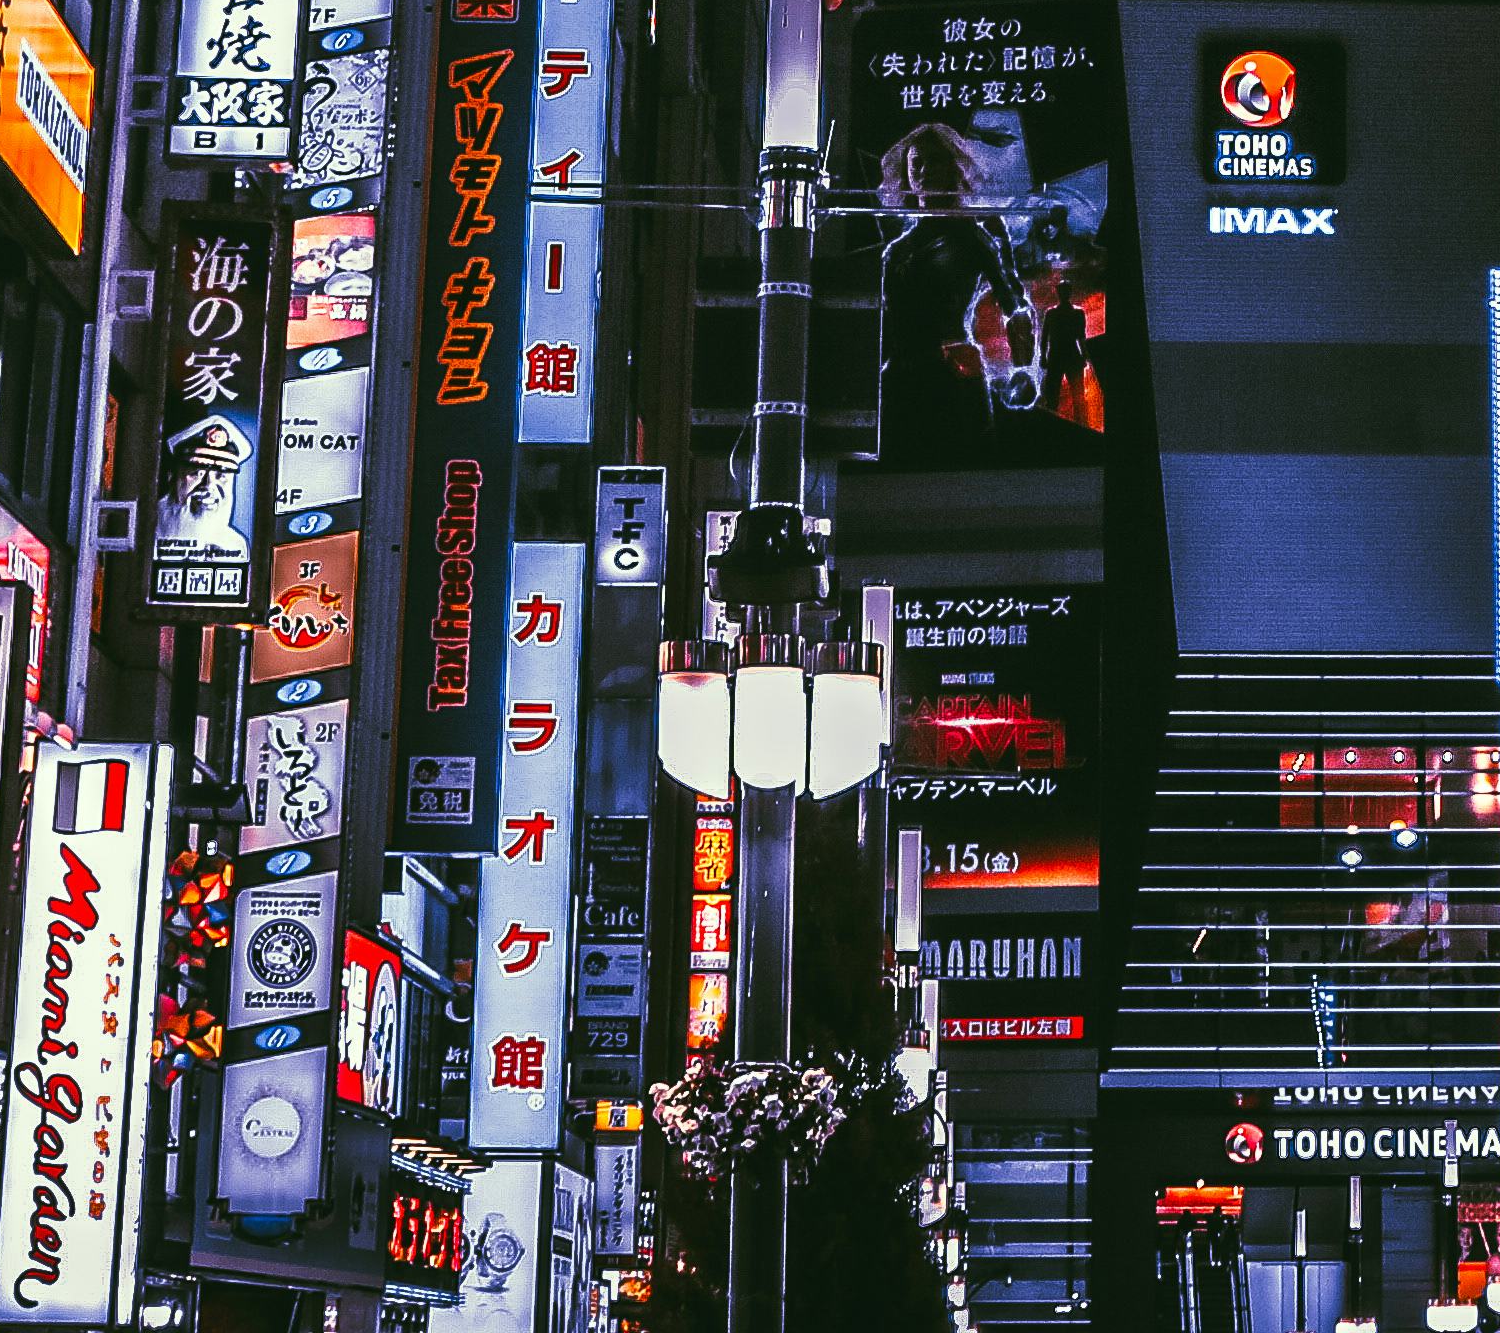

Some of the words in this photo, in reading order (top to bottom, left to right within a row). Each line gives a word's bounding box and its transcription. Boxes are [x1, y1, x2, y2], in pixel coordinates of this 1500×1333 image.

[311, 7, 337, 24] 7F
[334, 31, 352, 50] 6
[942, 16, 1022, 44] 彼女の
[179, 81, 286, 126] 大阪家
[900, 80, 1056, 111] 世界を変える。
[17, 49, 87, 190] TORIKIZOKU
[1217, 134, 1288, 157] TOHO
[1217, 157, 1314, 178] CINEMAS
[321, 189, 339, 207] 5
[435, 47, 516, 406] マツモトキヨシ
[1209, 206, 1338, 235] IMAX
[182, 235, 250, 405] 海の家
[319, 434, 359, 452] CAT
[275, 488, 304, 506] 4F
[436, 458, 484, 554] Shop
[612, 493, 642, 573] TFC
[298, 561, 322, 580] 3F
[434, 557, 474, 639] Free
[905, 624, 1029, 649] 誕生前の物語
[427, 641, 470, 712] Tax
[289, 681, 310, 701] 2
[314, 722, 341, 743] 2F
[418, 791, 464, 812] 免税
[489, 593, 564, 1092] カラオケ館
[584, 903, 640, 928] Cafe
[44, 843, 103, 1064] Miami
[918, 936, 1083, 981] MARUHAN
[587, 1021, 630, 1031] BRAND
[587, 1031, 630, 1048] 729
[1273, 1126, 1367, 1159] TOHO
